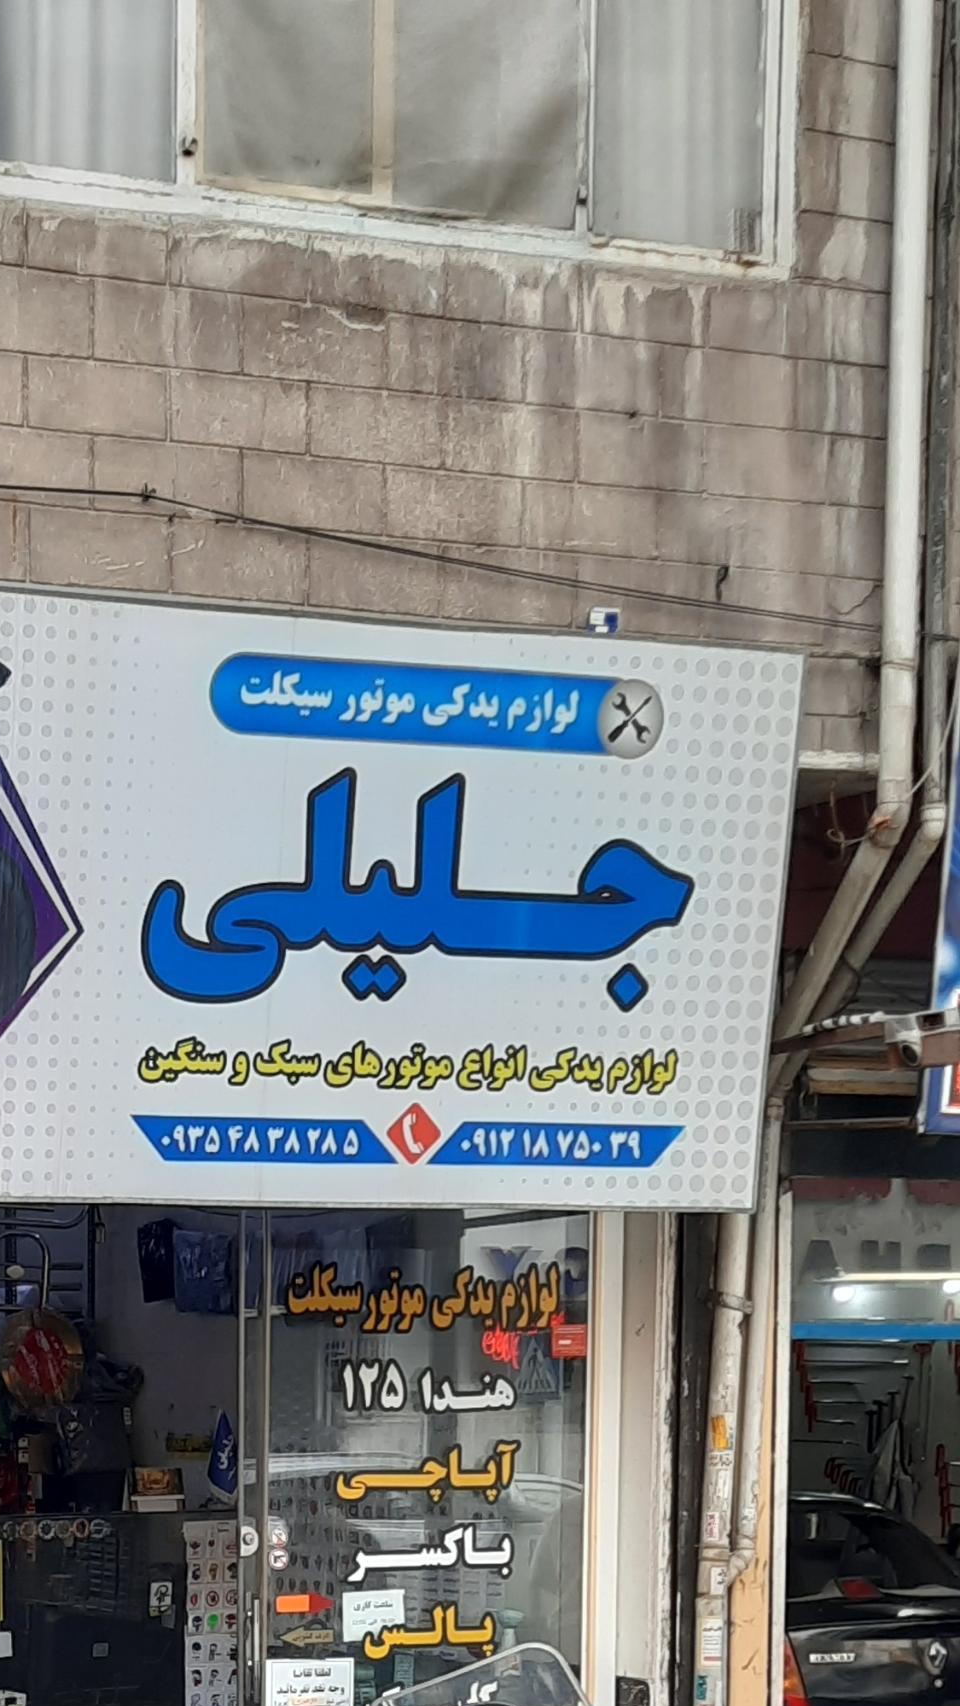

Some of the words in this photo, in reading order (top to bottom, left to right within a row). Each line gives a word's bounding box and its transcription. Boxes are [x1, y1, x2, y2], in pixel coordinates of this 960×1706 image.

[240, 671, 333, 716] سیکلت
[339, 679, 415, 723] موتور
[423, 683, 498, 727] یدکی
[507, 689, 579, 733] لوازم
[141, 767, 695, 1012] جلیلی
[138, 1036, 227, 1083] سنگین
[228, 1051, 250, 1086] و
[253, 1038, 321, 1085] سبک
[456, 1043, 527, 1092] انواع
[528, 1047, 605, 1092] یدکی
[606, 1049, 679, 1095] لوازم
[287, 1260, 364, 1327] سیکلت
[360, 1265, 427, 1333] موتور
[430, 1265, 495, 1331] یدکی
[500, 1261, 560, 1330] لوازم
[342, 1359, 407, 1411] ۱۲۵
[419, 1366, 518, 1414] هندا
[336, 1439, 521, 1504] آپاچی
[345, 1523, 513, 1583] باکسر
[363, 1602, 496, 1659] پالس
